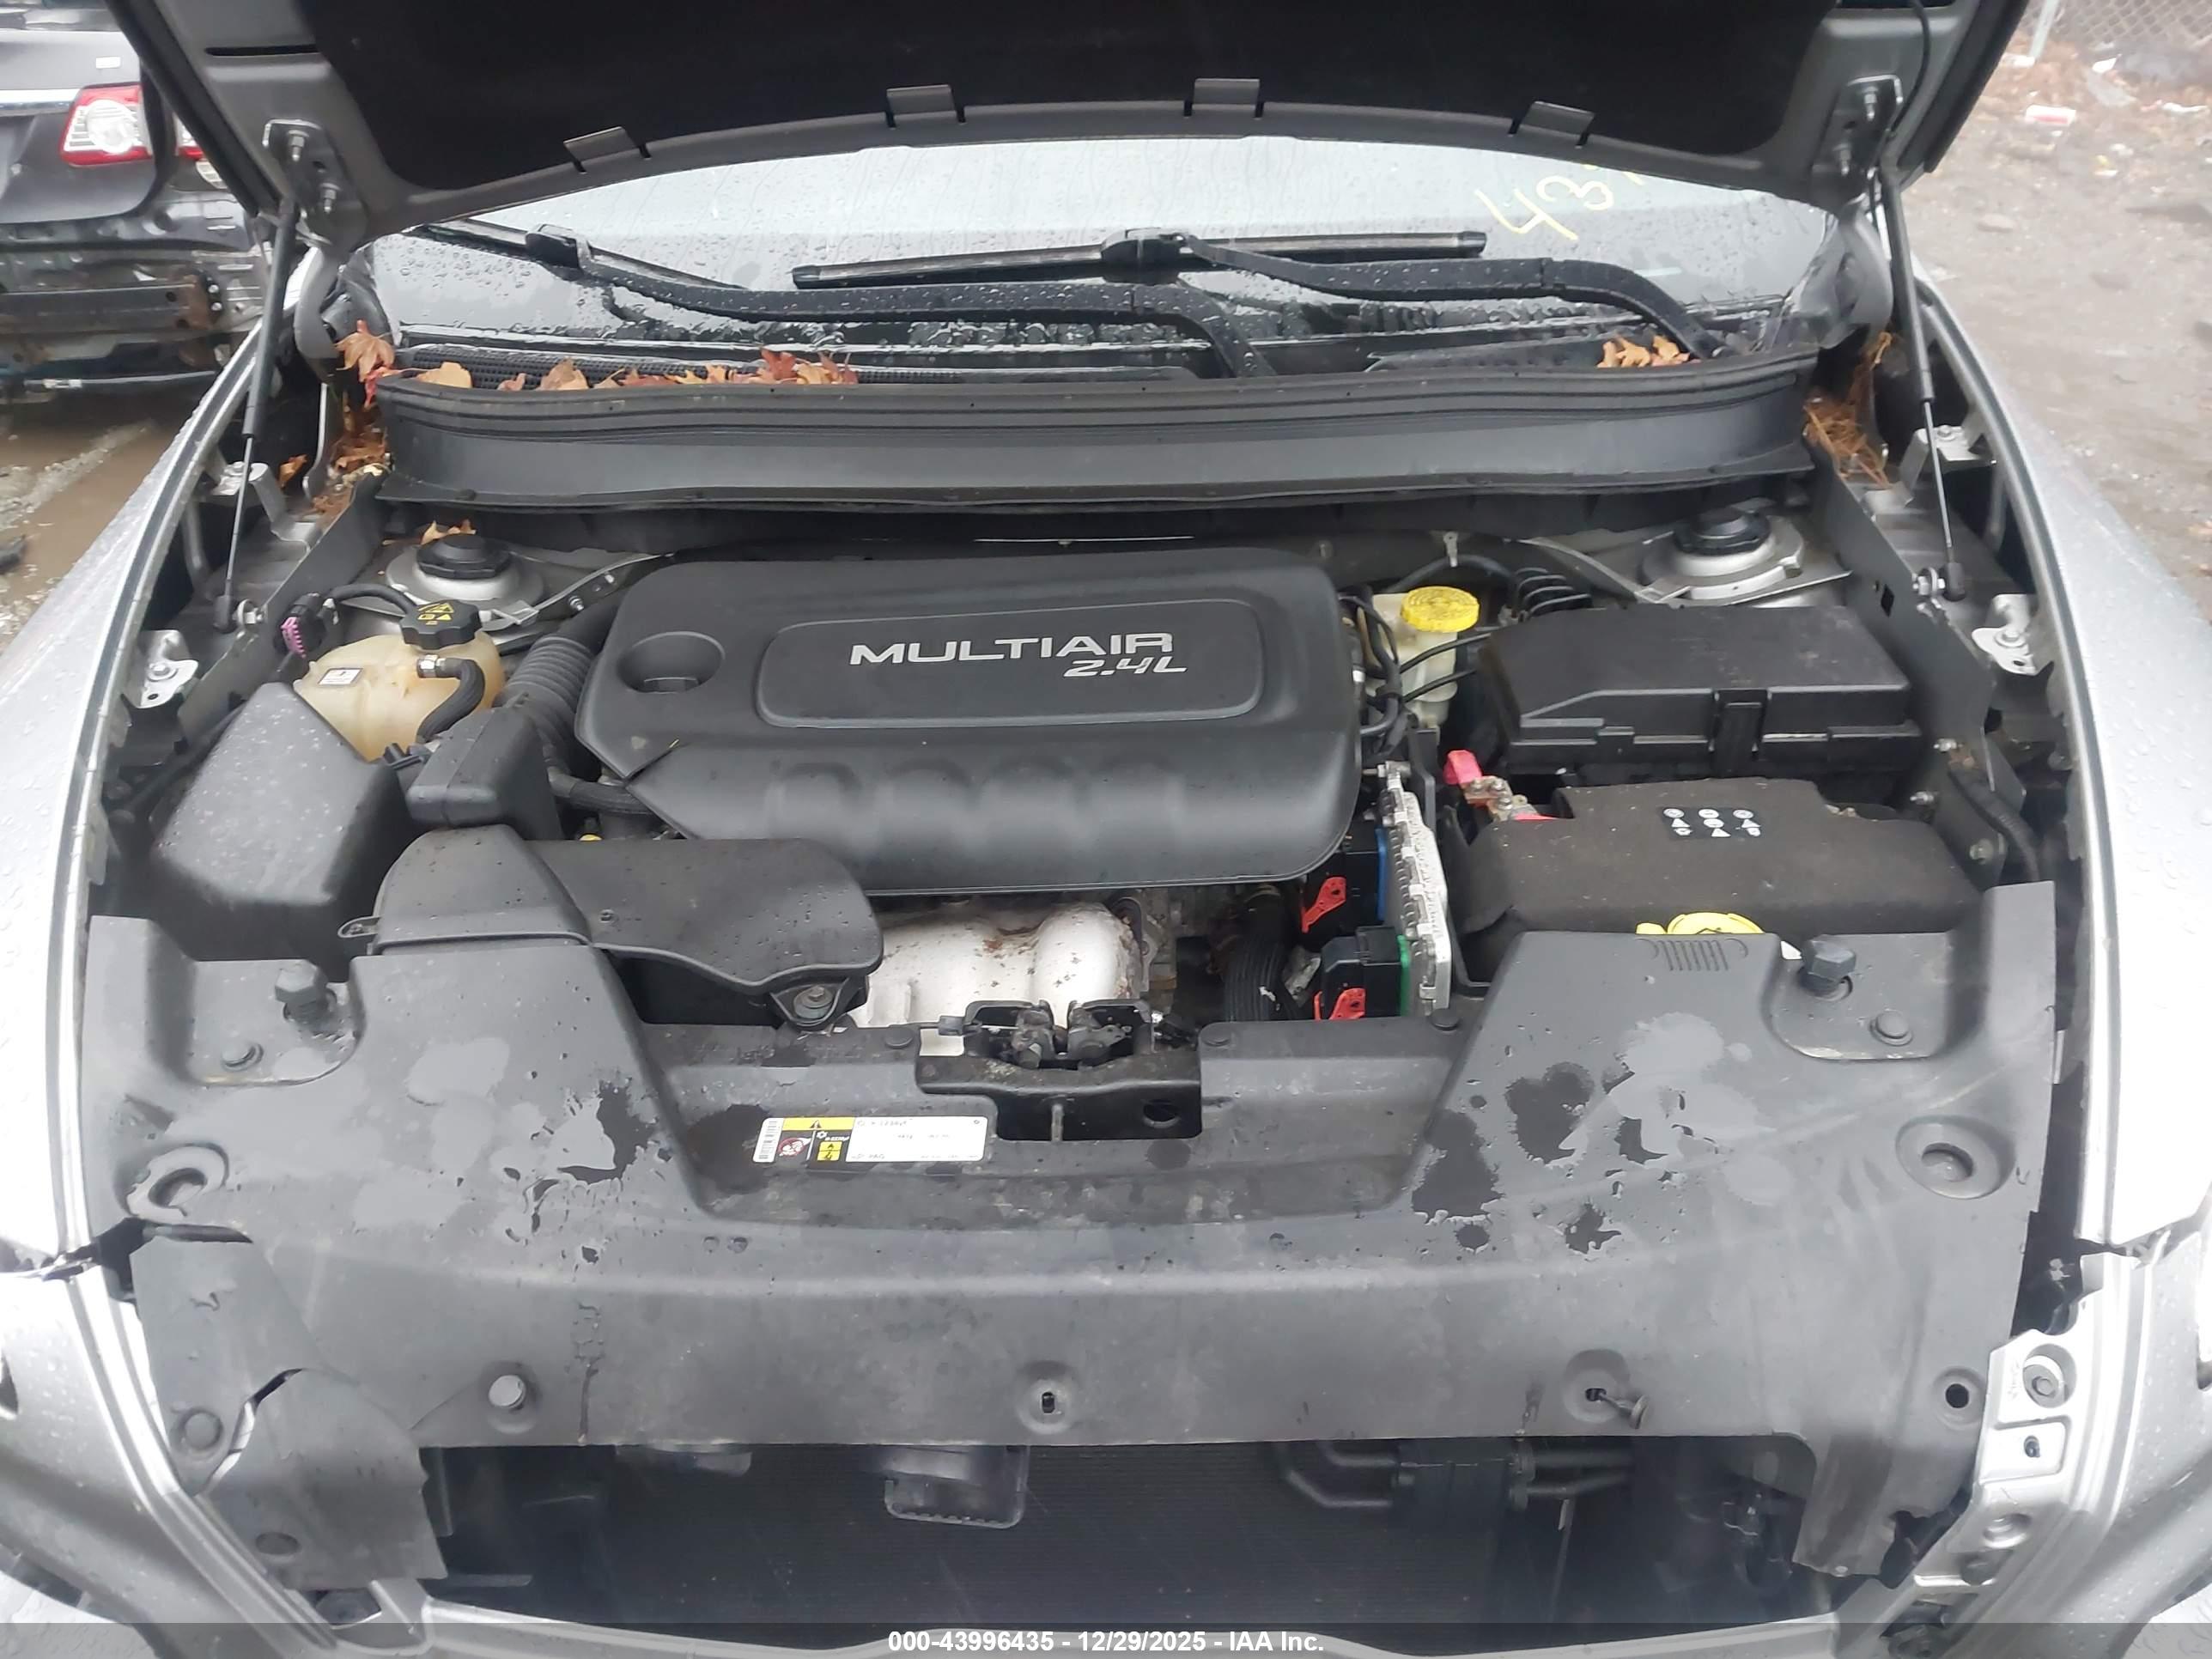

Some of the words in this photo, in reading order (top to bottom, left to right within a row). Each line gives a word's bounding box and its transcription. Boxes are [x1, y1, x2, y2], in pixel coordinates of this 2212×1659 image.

[1474, 164, 1644, 240] 43
[849, 632, 1173, 665] MULTIAIR
[1063, 655, 1188, 678] 2.4L
